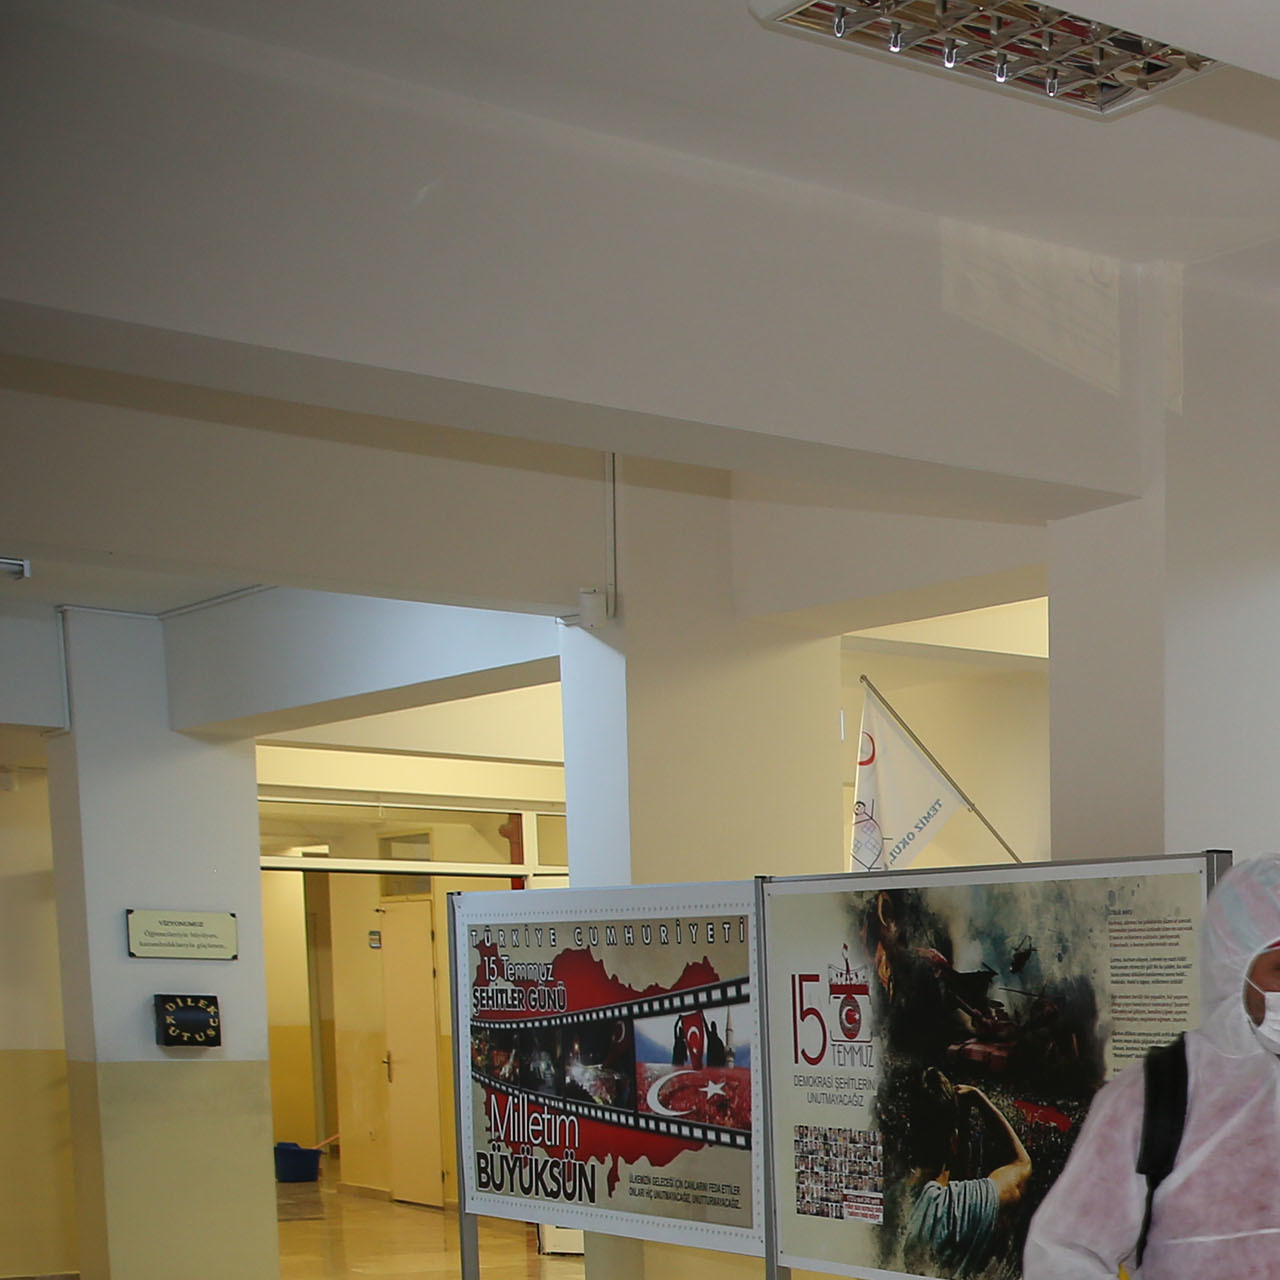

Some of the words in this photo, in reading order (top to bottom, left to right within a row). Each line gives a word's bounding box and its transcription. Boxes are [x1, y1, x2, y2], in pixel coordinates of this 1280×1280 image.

[471, 924, 557, 948] TÜRKİYE
[573, 917, 745, 946] CUMHURİYETİ
[483, 956, 498, 981] 15
[500, 956, 554, 982] Temmuz
[165, 997, 218, 1016] DİLEK
[473, 983, 525, 1016] ŞEHİTLER
[527, 981, 566, 1011] GÜNÜ
[165, 1015, 219, 1042] KUTUSU
[792, 974, 828, 1066] 15
[831, 1043, 874, 1068] TEMMUZ
[793, 1074, 833, 1088] DEMOKRASİ
[807, 1091, 864, 1107] UNUTMAYACAĞIZ
[476, 1141, 597, 1205] BÜYÜKSÜN
